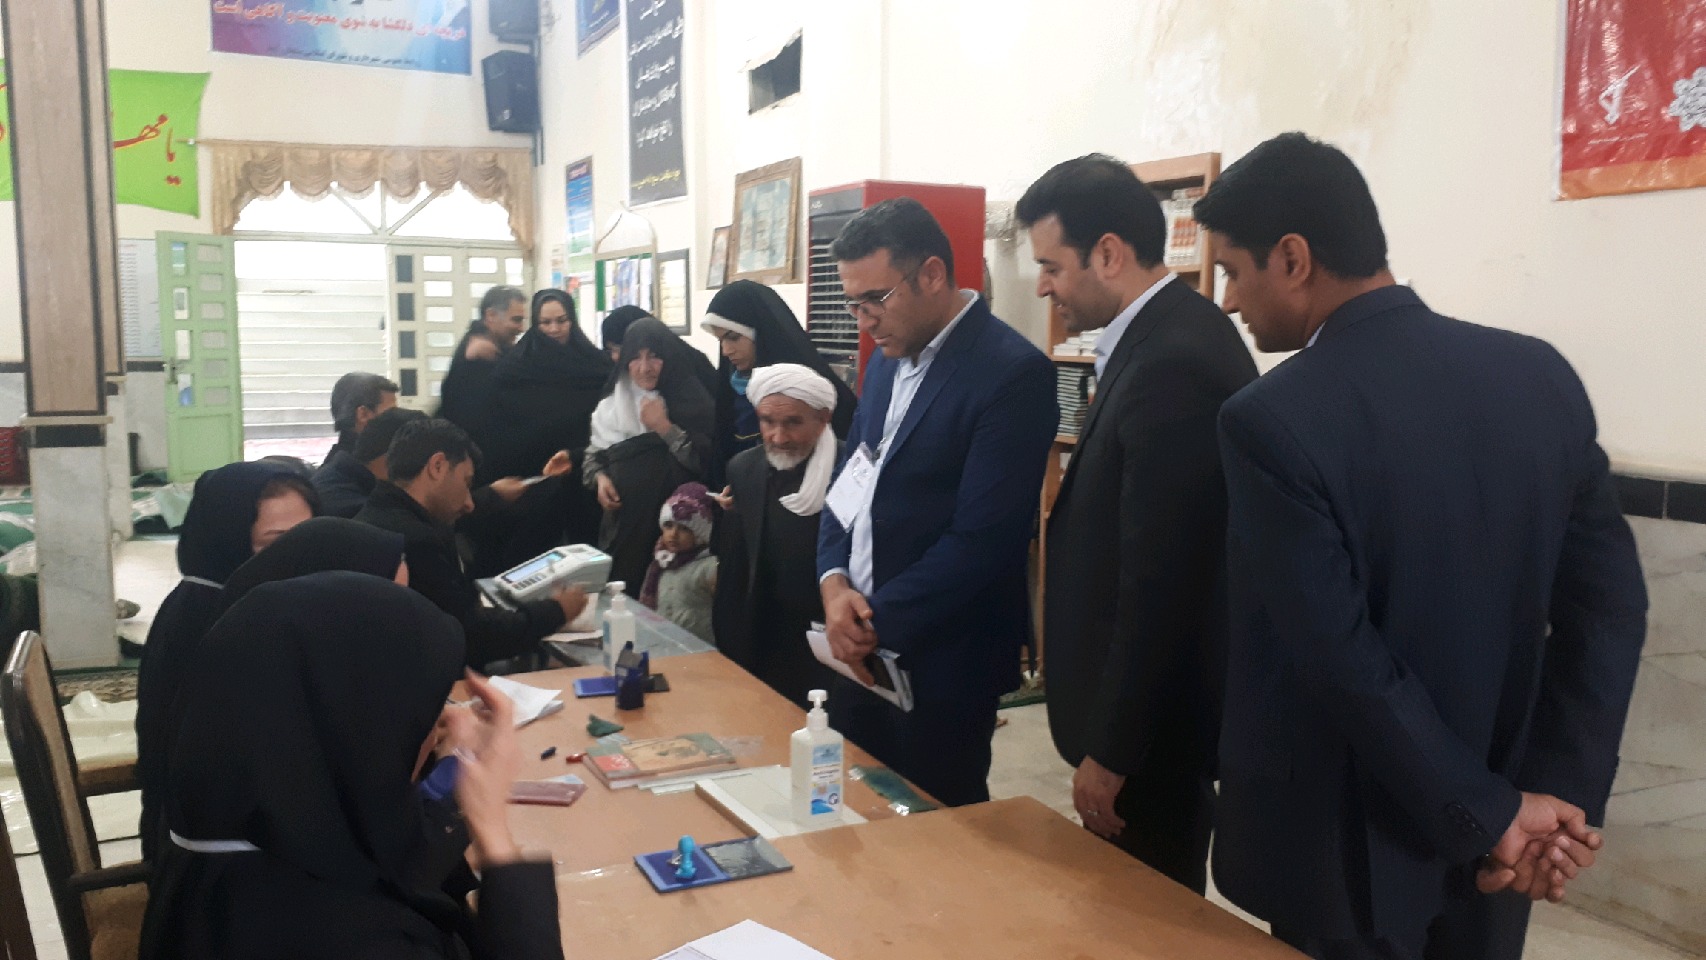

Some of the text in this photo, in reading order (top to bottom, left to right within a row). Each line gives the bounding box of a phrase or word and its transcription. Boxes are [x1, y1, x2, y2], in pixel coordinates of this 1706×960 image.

[297, 10, 337, 26] معنویت
[370, 17, 380, 29] به
[381, 16, 413, 32] دلگشا
